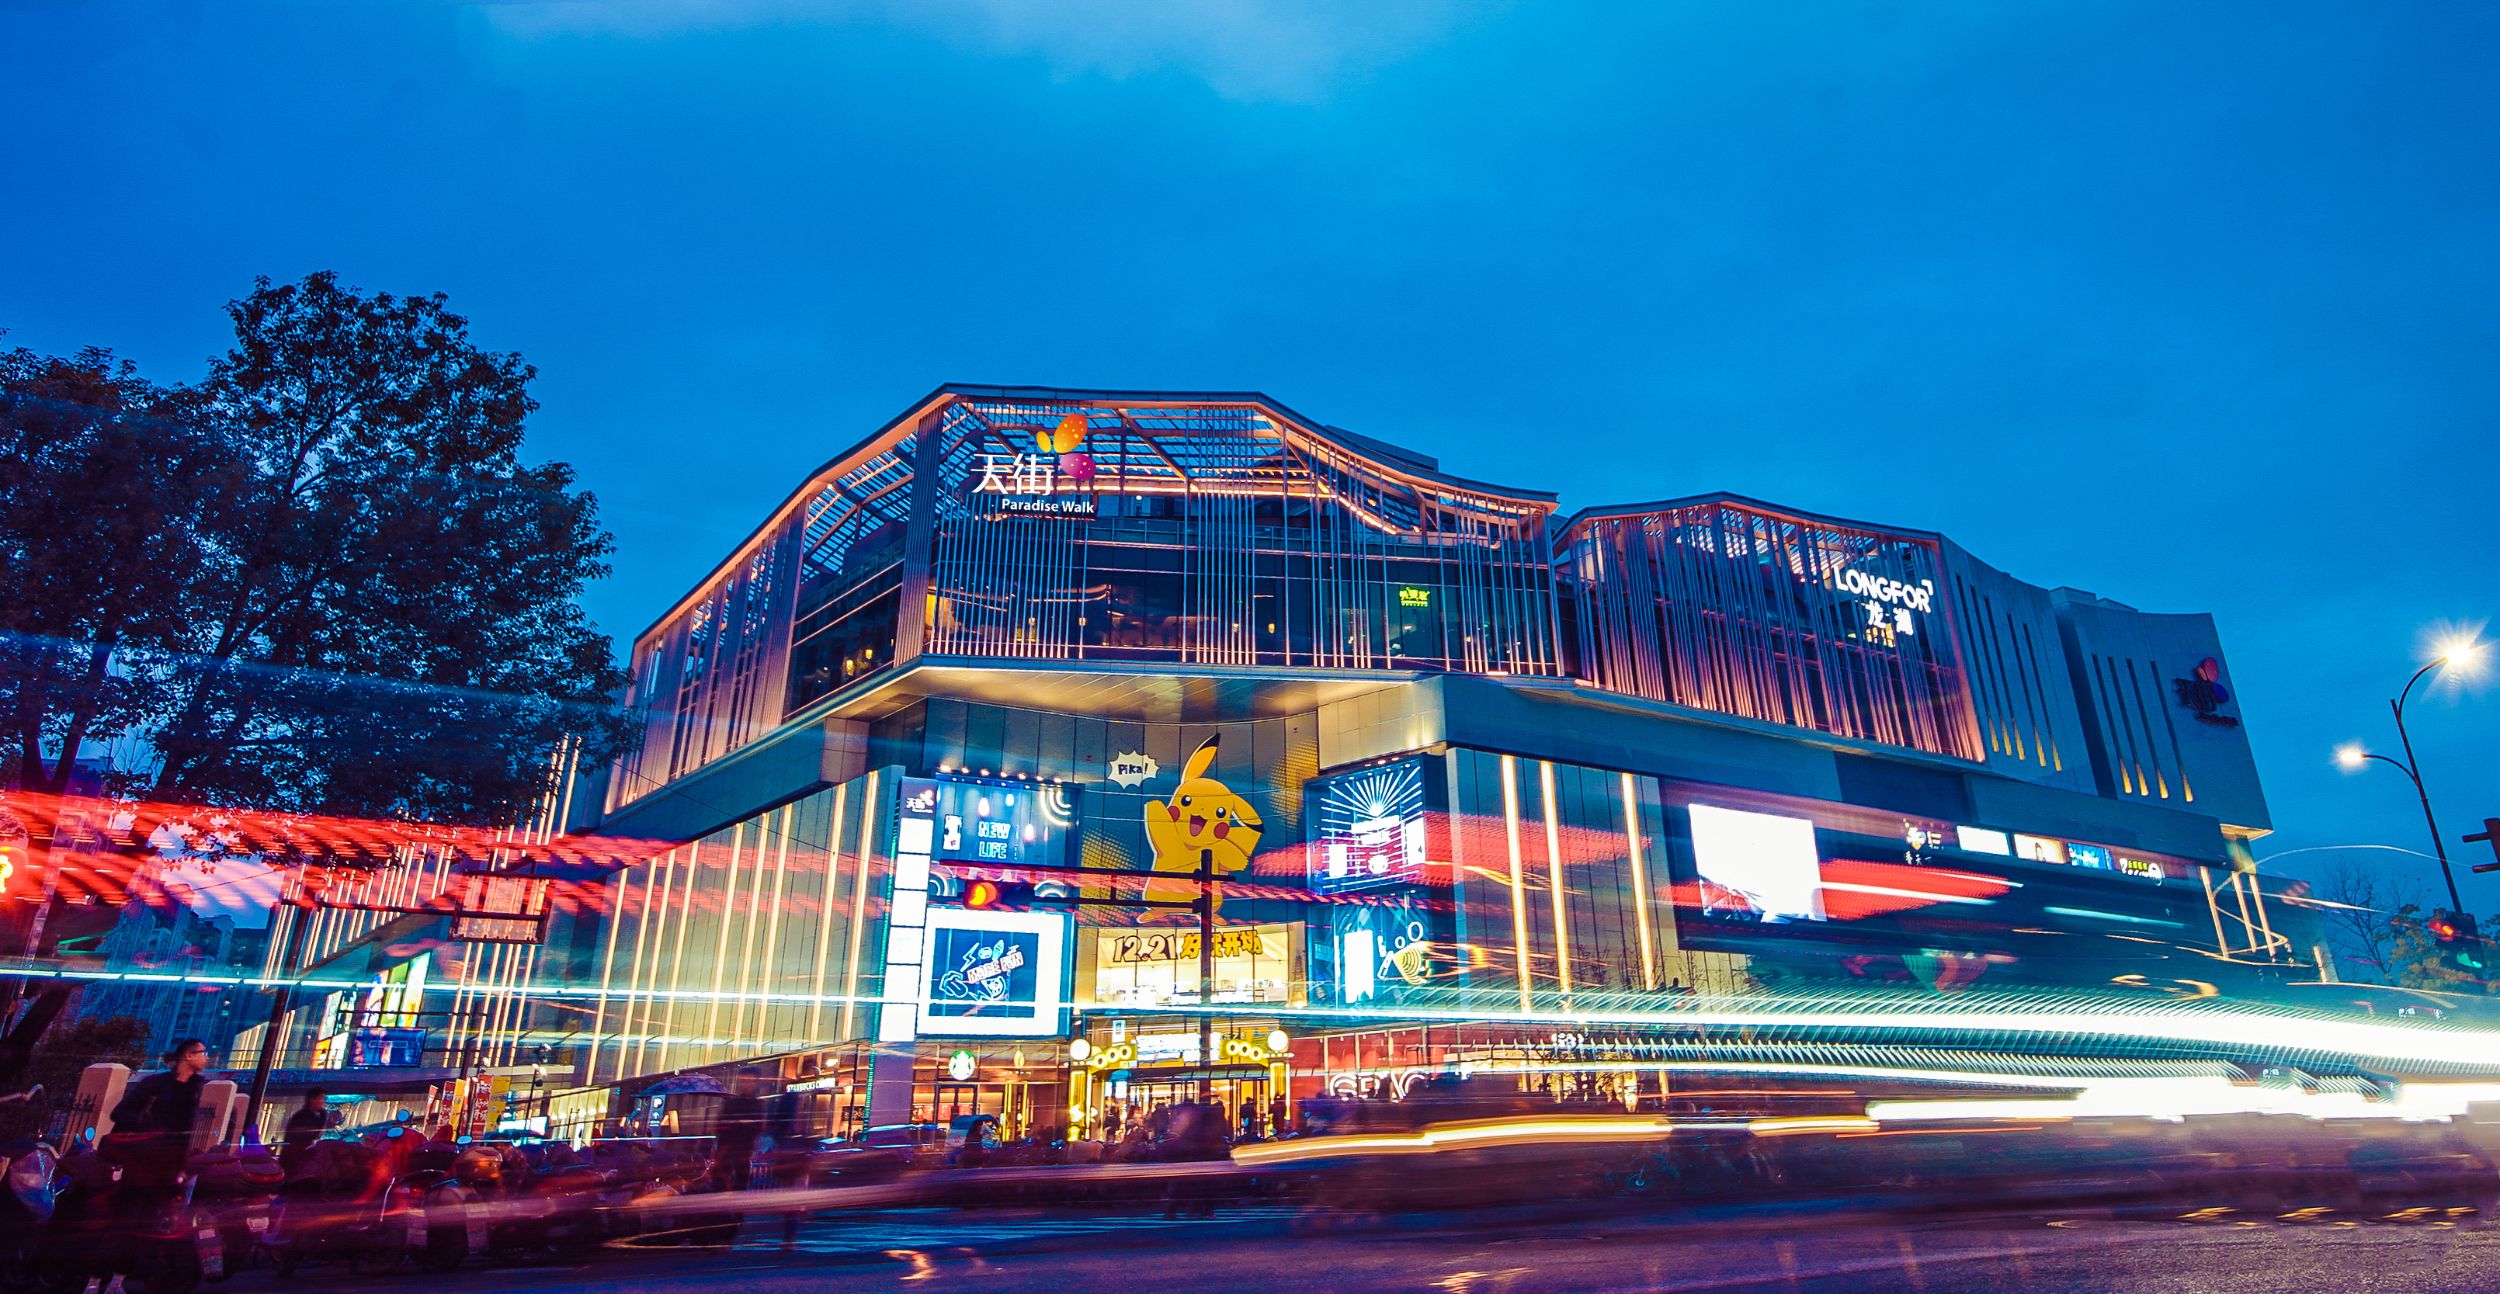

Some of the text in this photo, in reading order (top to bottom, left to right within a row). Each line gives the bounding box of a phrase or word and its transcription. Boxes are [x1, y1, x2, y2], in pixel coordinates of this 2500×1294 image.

[970, 453, 1055, 496] 天街
[1001, 498, 1095, 513] Paradise Walk
[1833, 564, 1932, 614] LONGFOR
[1117, 762, 1149, 776] Pika!
[978, 820, 1011, 840] NEW
[978, 841, 1008, 859] LIFE
[1113, 933, 1179, 963] 12.21
